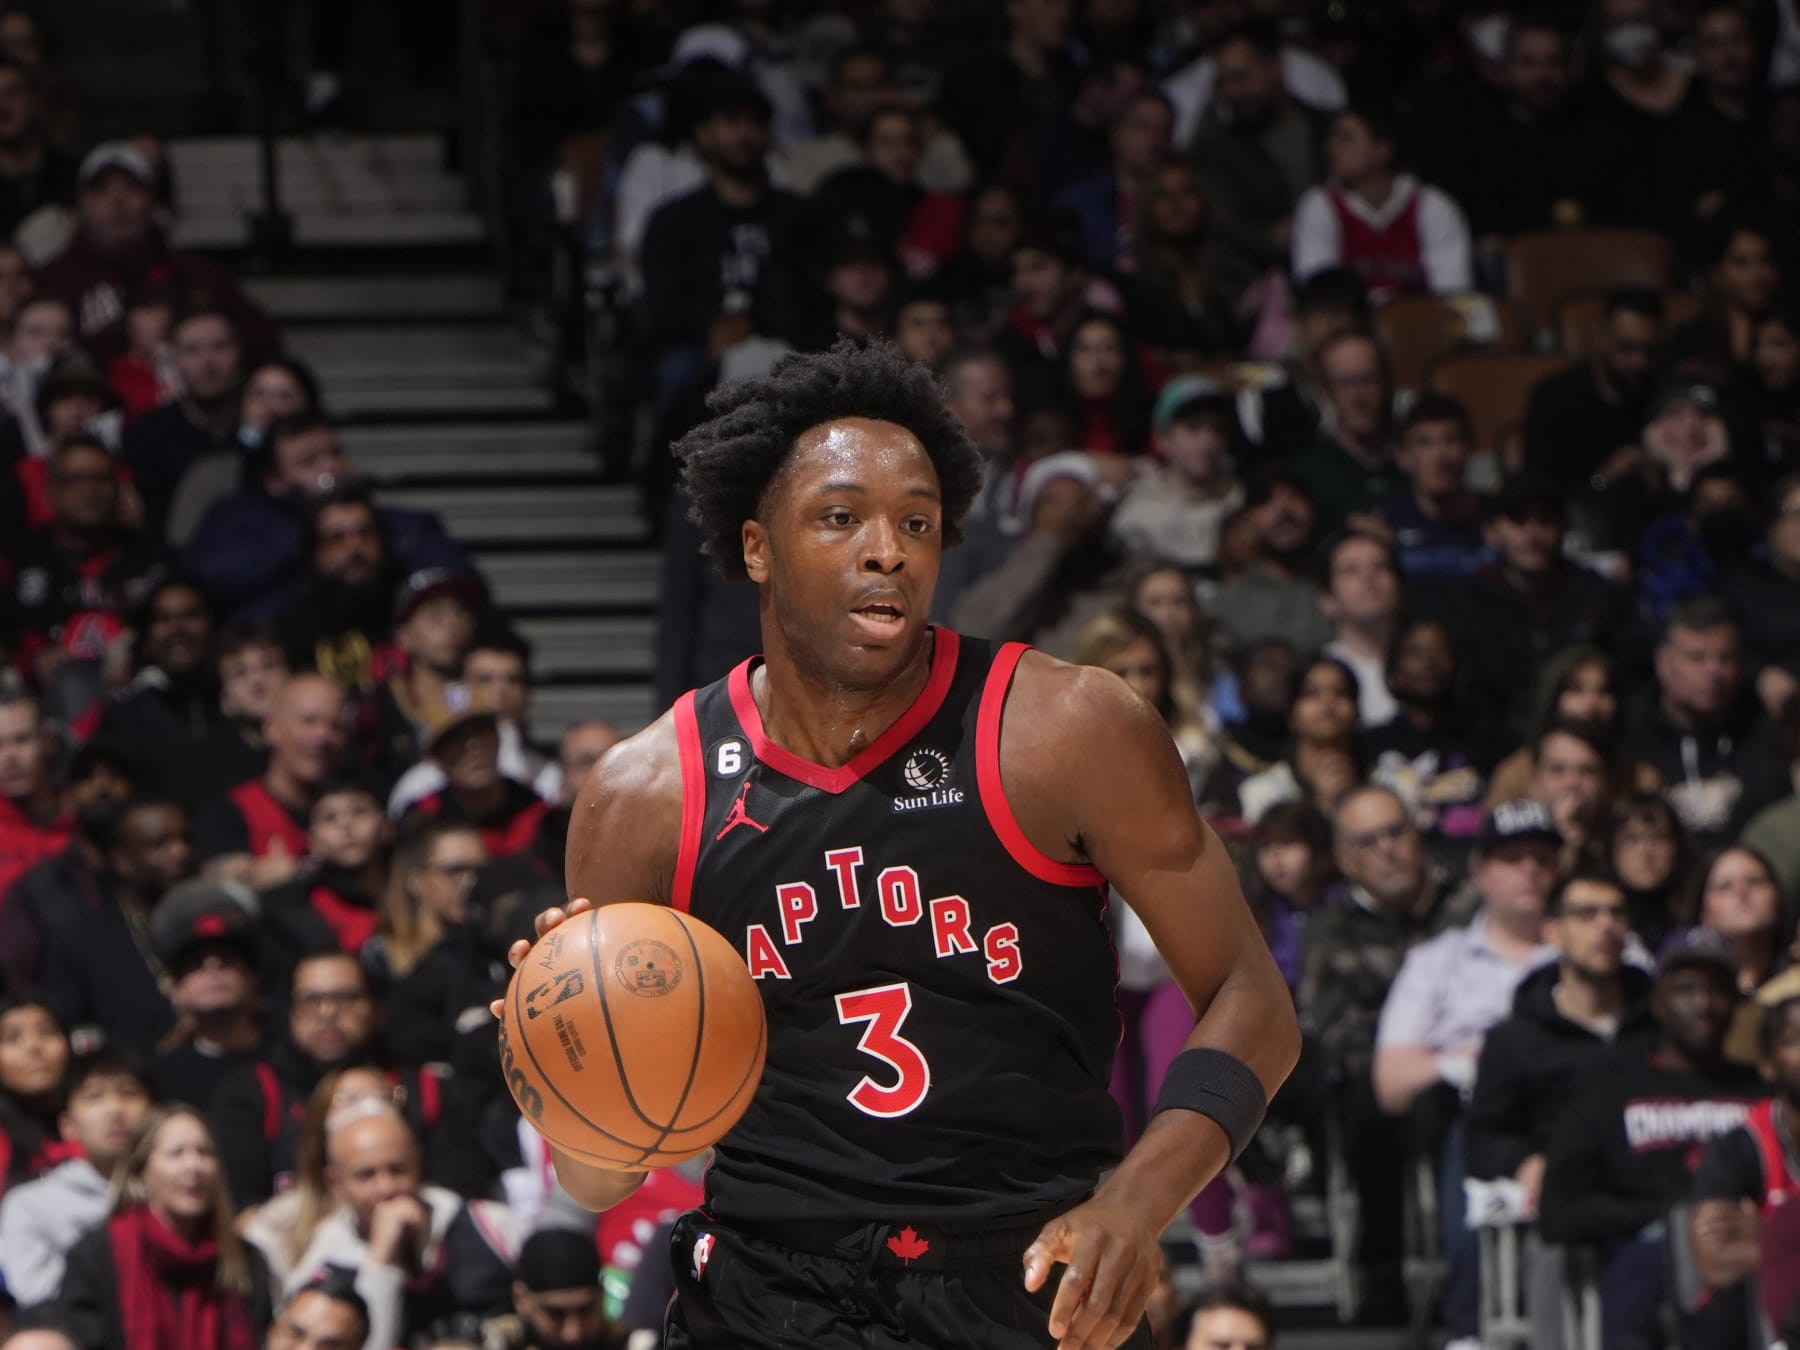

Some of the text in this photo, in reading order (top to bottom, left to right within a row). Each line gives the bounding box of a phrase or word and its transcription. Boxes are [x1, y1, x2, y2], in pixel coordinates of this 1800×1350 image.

[717, 741, 742, 775] 6
[894, 787, 965, 812] Sun Life
[747, 846, 1023, 985] APTORS
[834, 982, 931, 1119] 3
